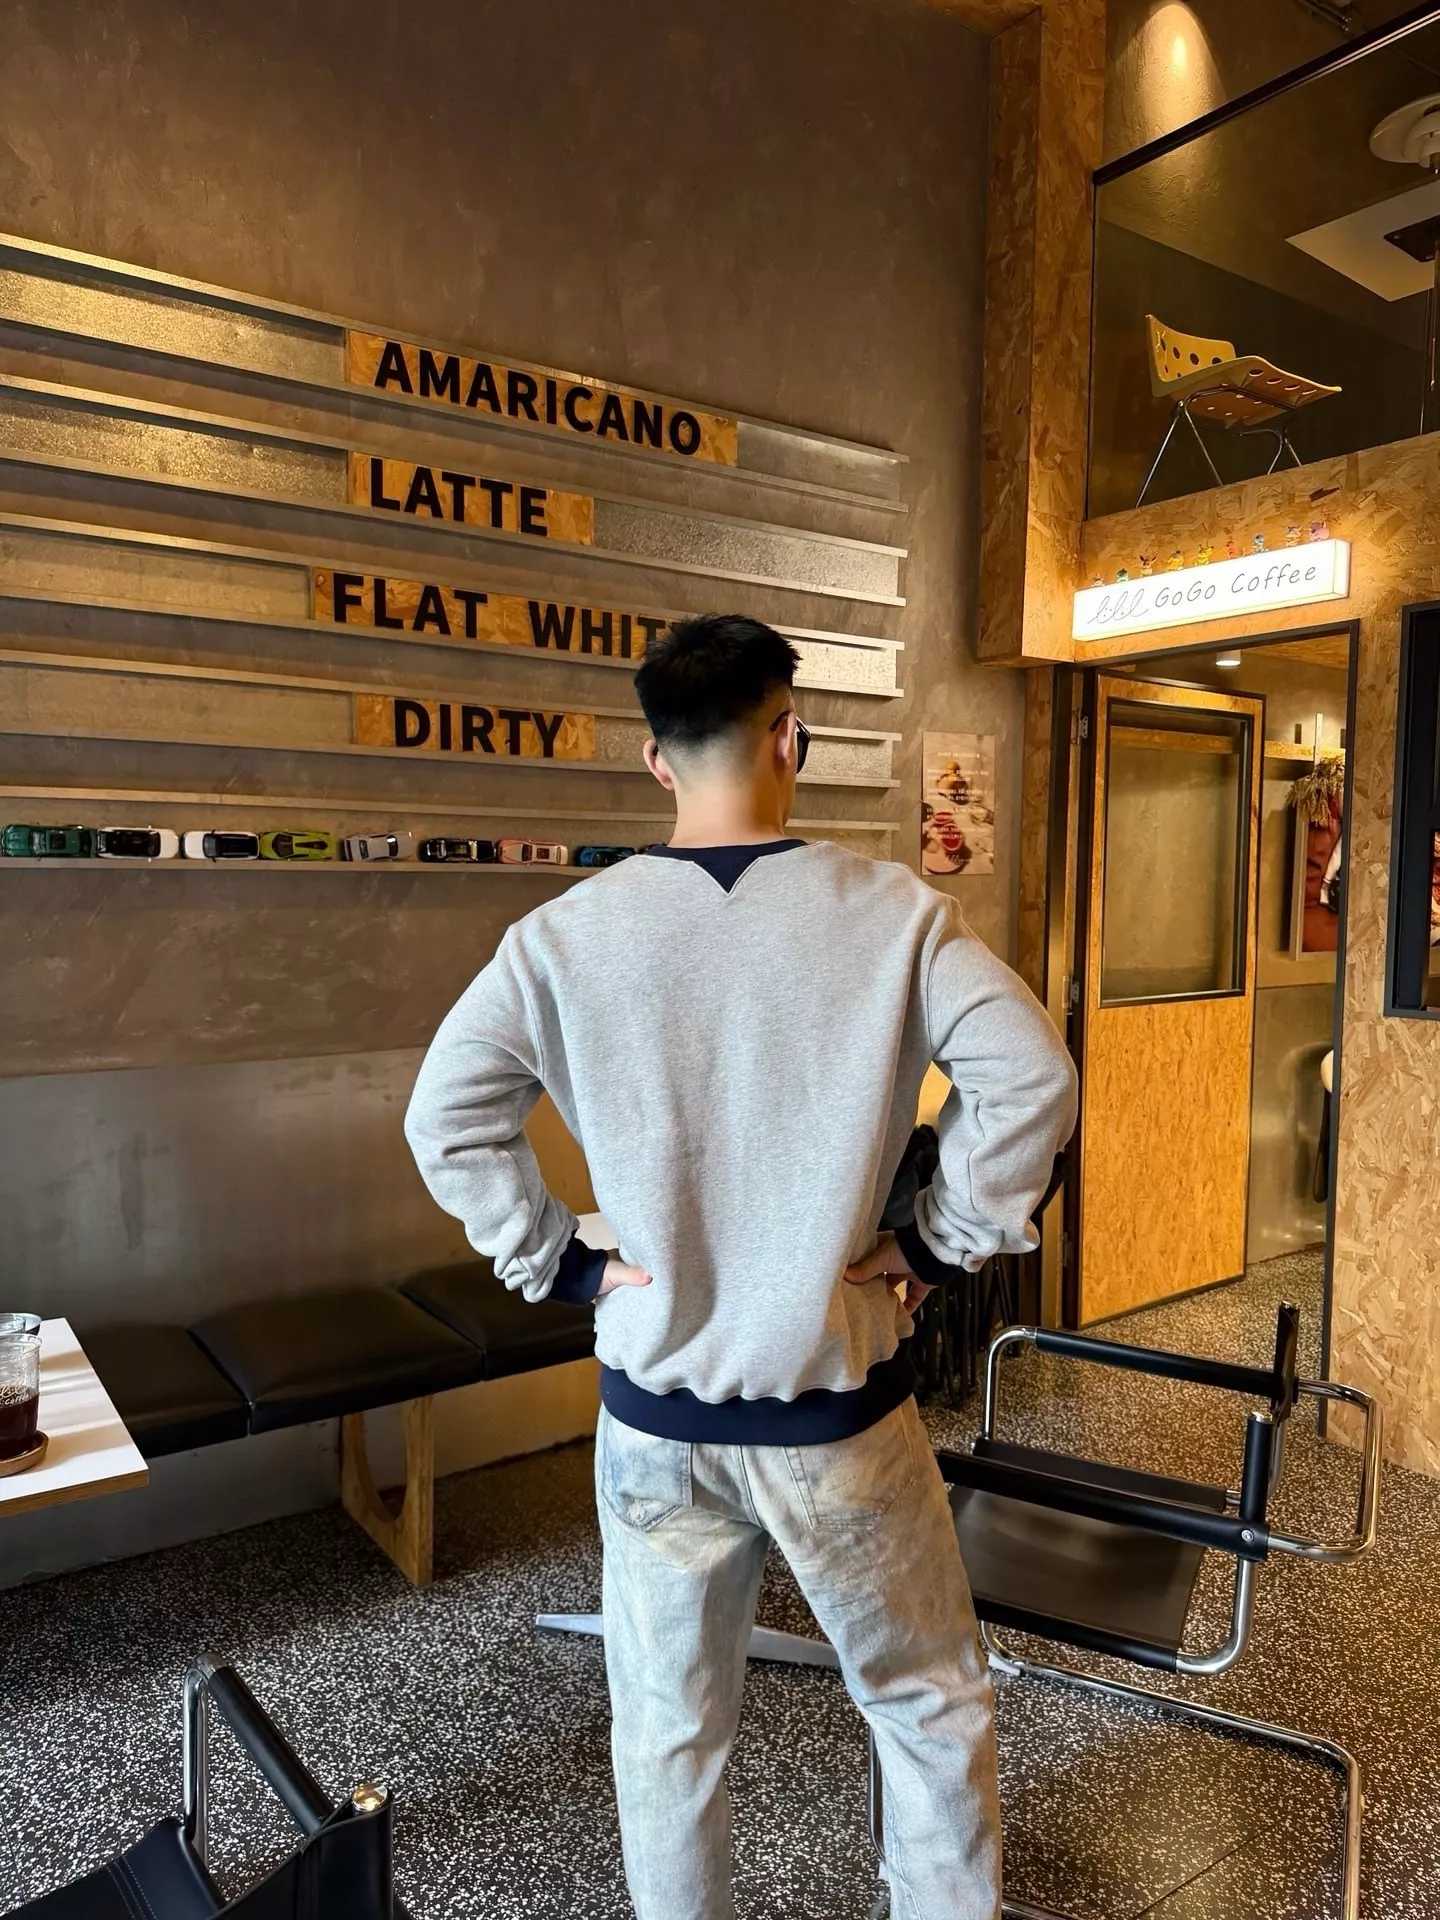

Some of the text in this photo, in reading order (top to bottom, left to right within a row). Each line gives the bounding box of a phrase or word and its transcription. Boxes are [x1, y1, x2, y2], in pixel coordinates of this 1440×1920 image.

[374, 341, 700, 455] AMARICANO
[370, 458, 547, 536] LATTE
[333, 573, 682, 660] FLAT WHIT
[1155, 581, 1216, 608] GoGo
[1231, 563, 1316, 594] Coffee
[393, 699, 564, 758] DIRTY
